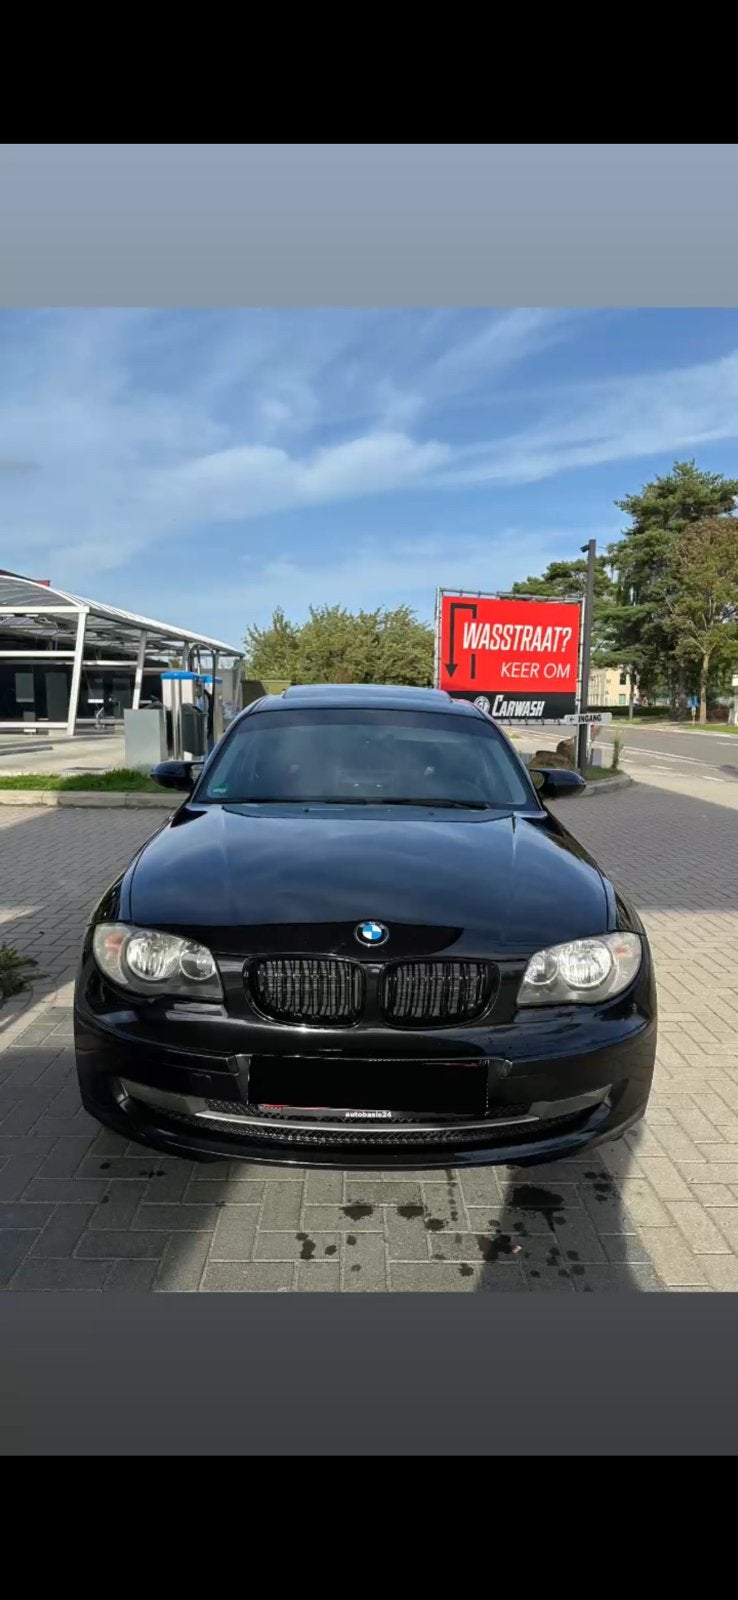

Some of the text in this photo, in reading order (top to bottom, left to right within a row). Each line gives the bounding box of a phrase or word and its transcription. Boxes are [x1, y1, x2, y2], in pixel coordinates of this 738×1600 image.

[463, 622, 572, 652] WASSTRAAT?
[500, 662, 570, 679] KEER OM
[492, 695, 545, 716] CARWASH
